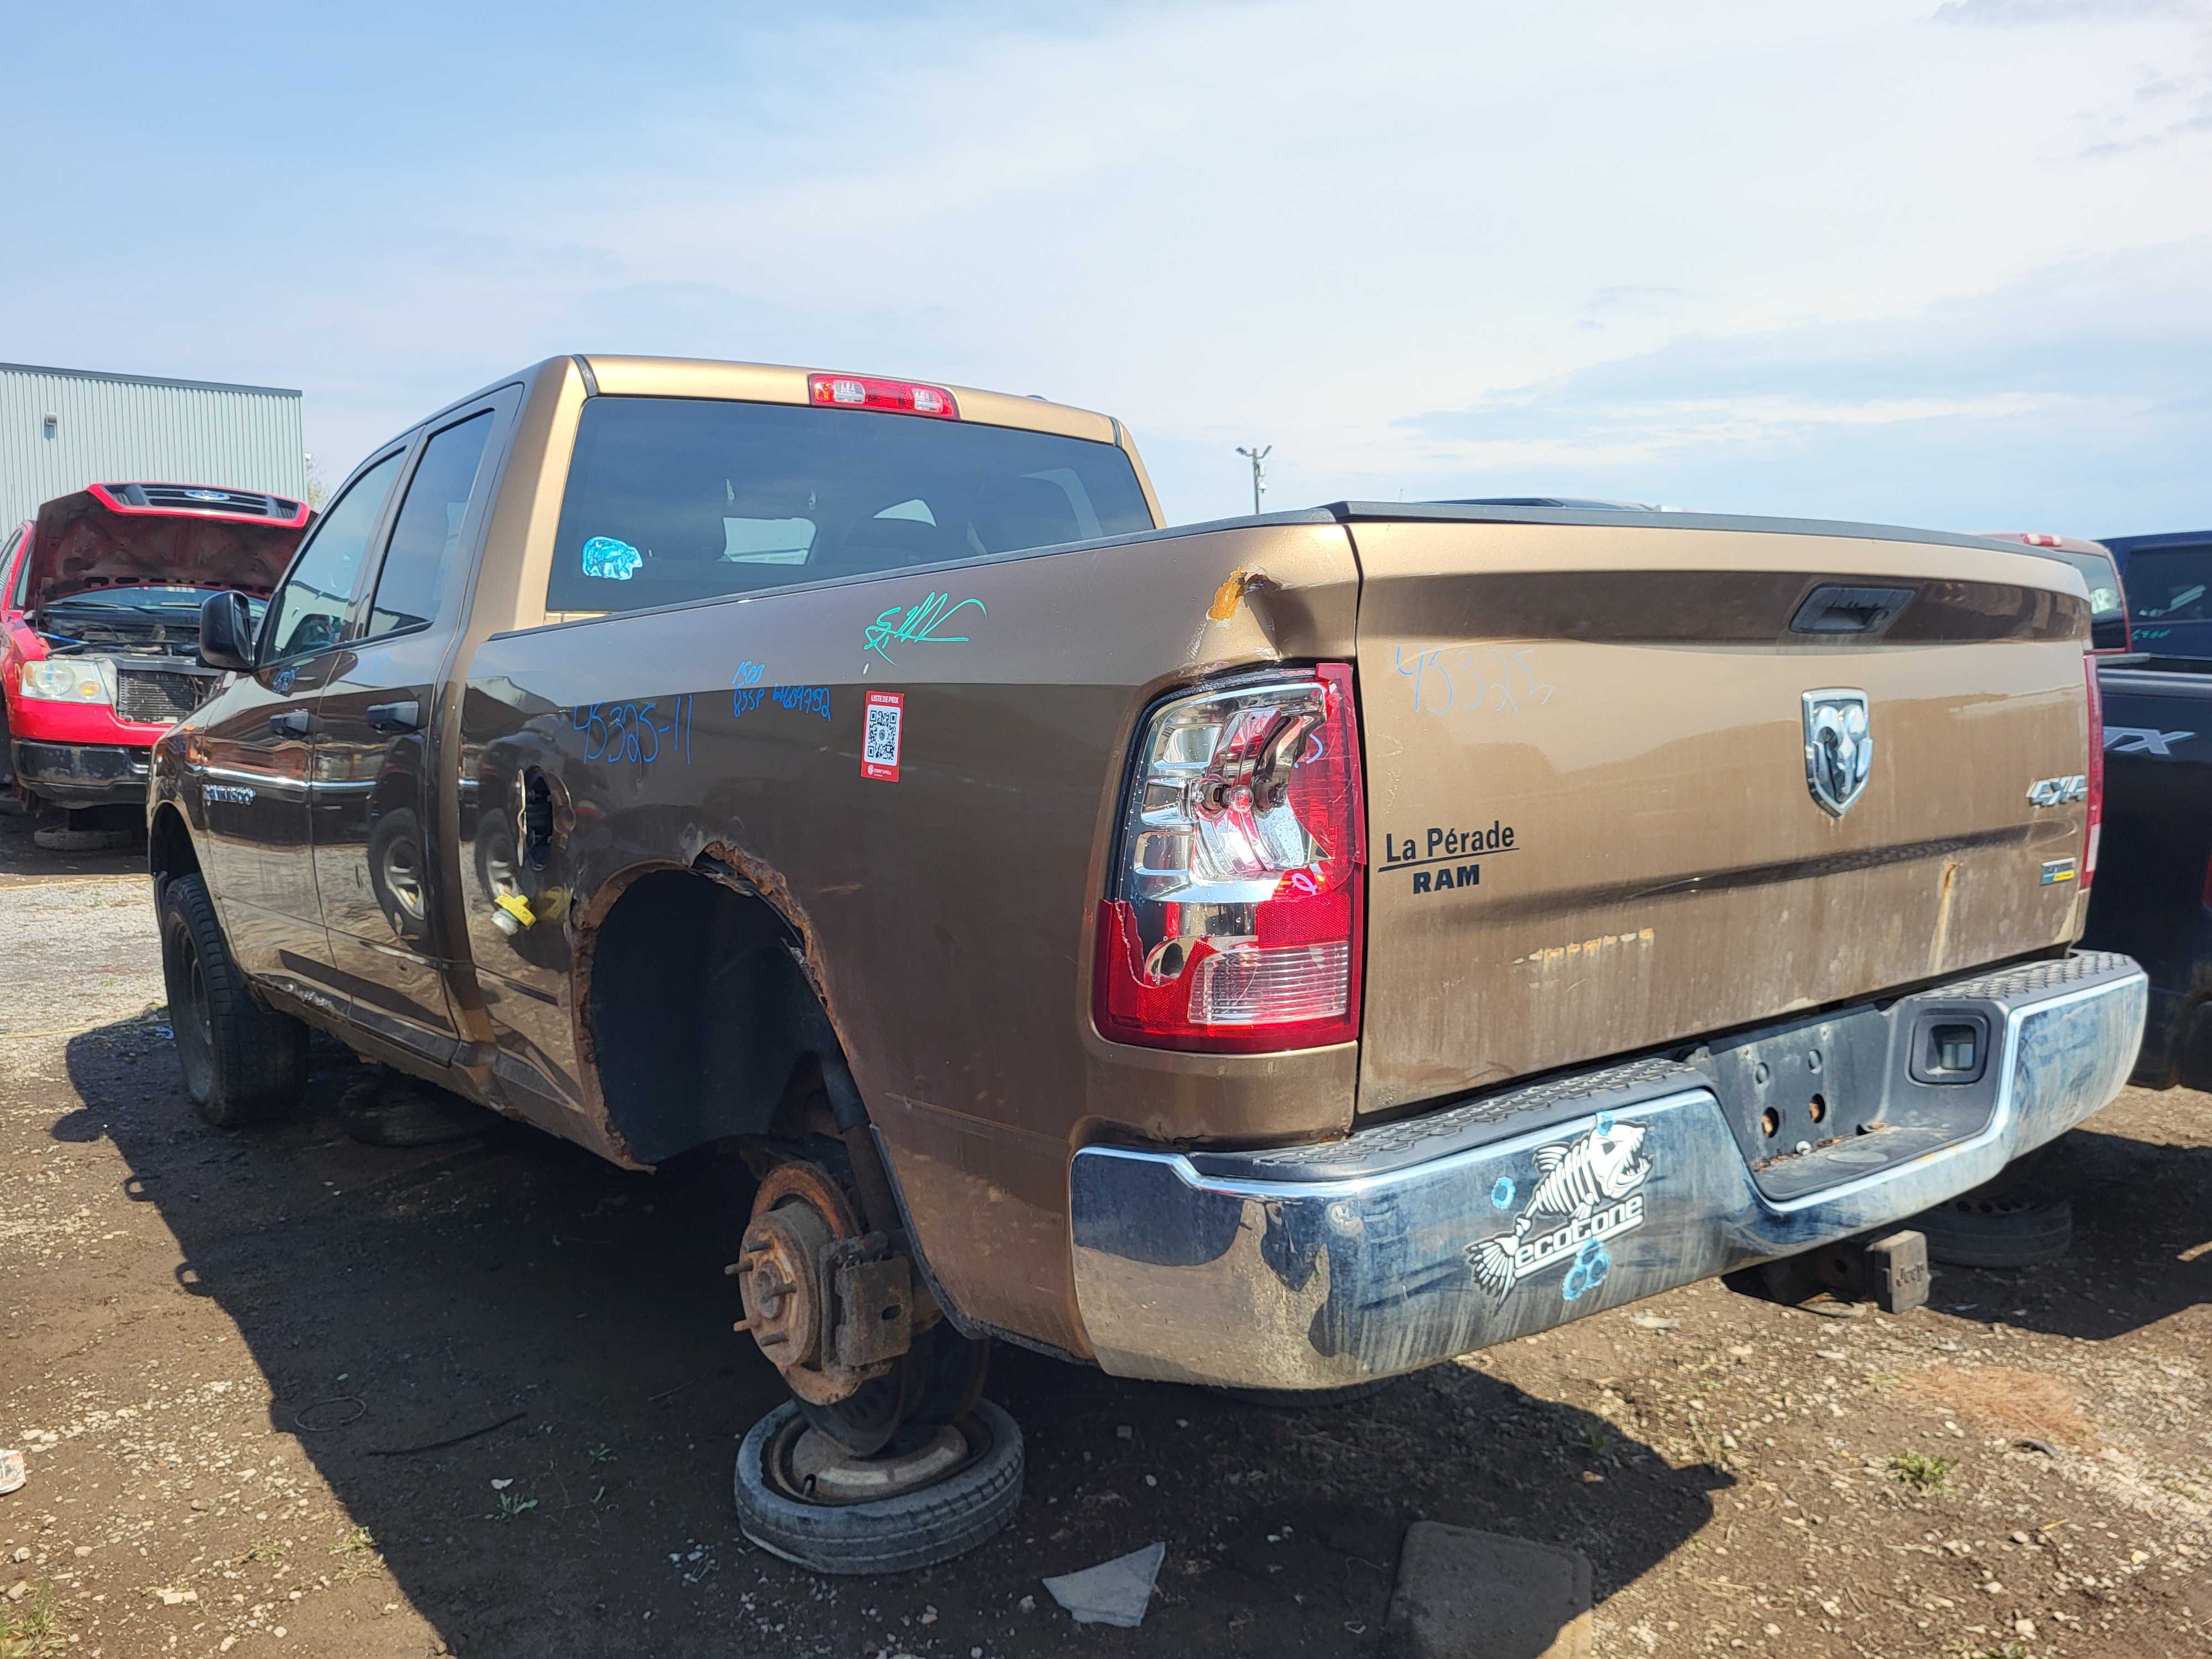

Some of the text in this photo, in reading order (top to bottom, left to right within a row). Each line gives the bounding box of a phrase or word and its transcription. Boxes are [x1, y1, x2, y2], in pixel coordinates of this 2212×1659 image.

[1386, 833, 1416, 863] La
[1427, 820, 1514, 857] Pérade
[1413, 864, 1479, 894] RAM
[1515, 1196, 1643, 1269] ecotone
